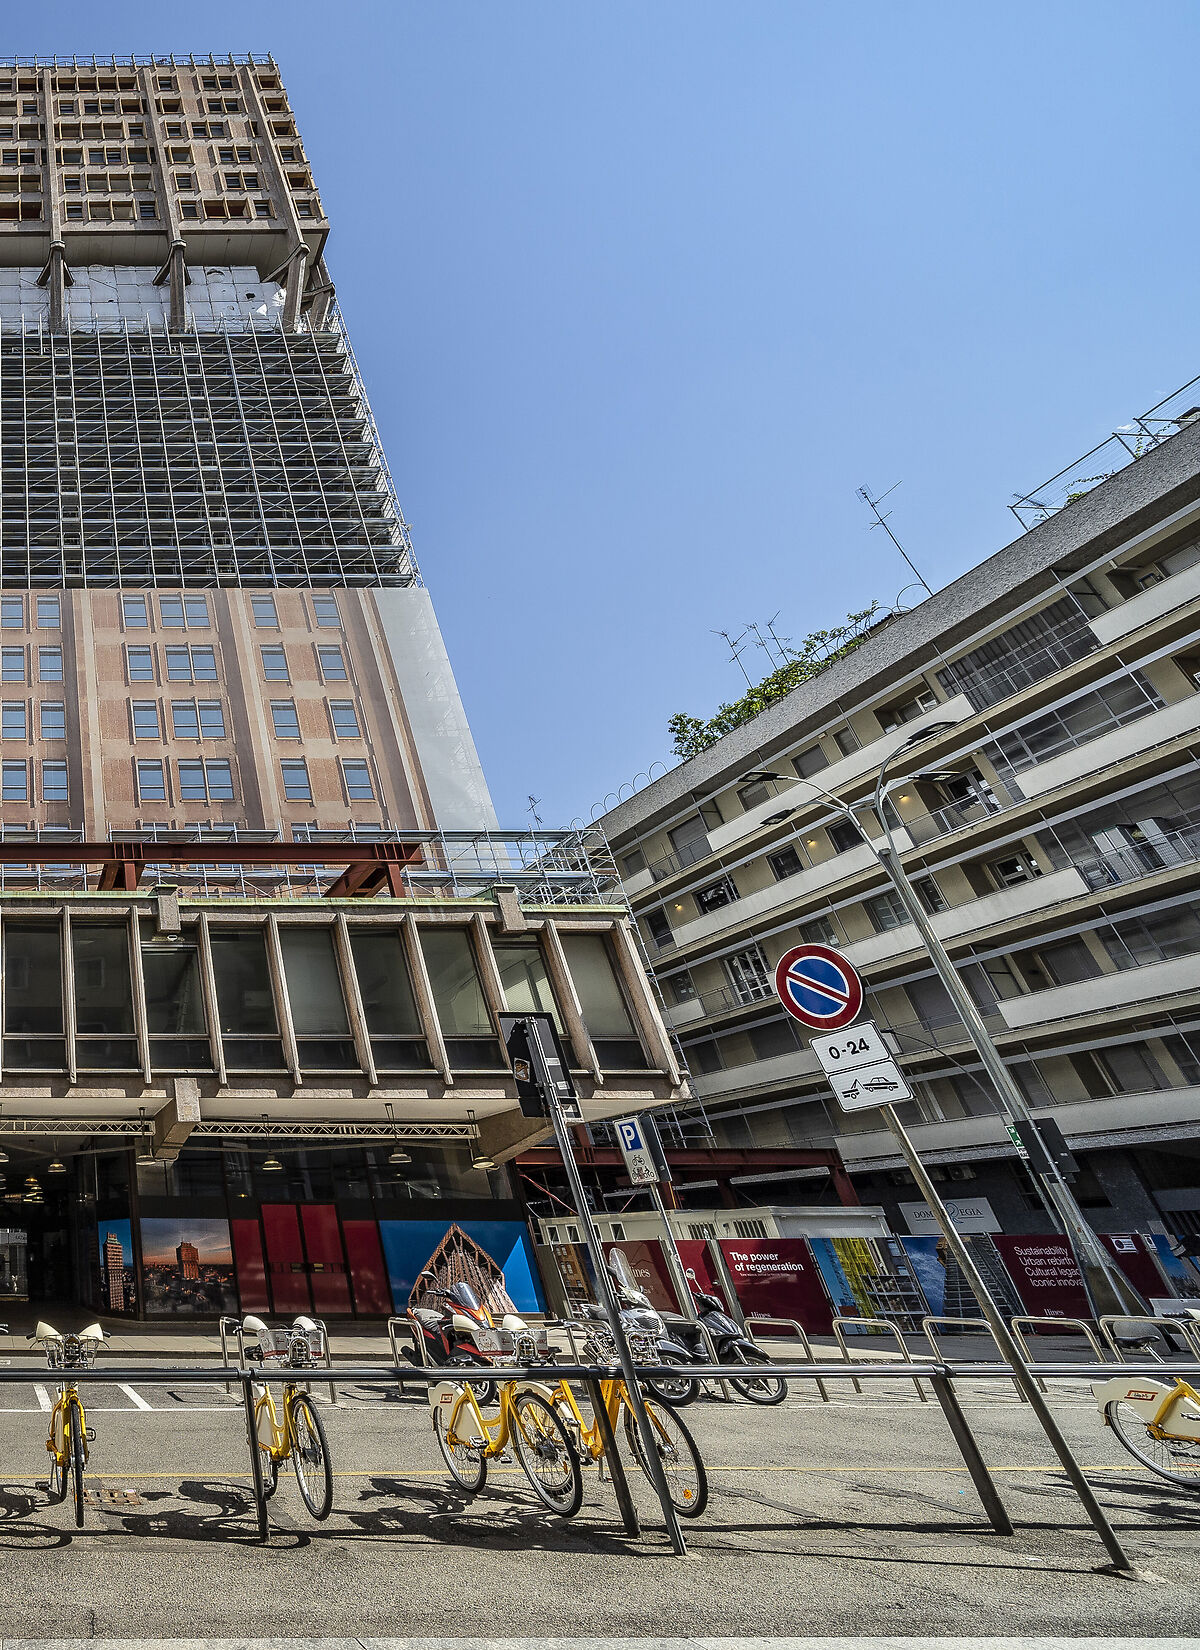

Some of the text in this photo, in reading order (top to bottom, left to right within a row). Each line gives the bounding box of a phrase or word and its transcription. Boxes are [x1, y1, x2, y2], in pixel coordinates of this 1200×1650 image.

[828, 1038, 870, 1059] 0-24
[621, 1124, 636, 1149] P
[729, 1251, 779, 1263] The power
[1013, 1246, 1069, 1257] Sustainability
[734, 1261, 805, 1273] of regeneration
[1018, 1256, 1075, 1266] Urban rebirth
[631, 1266, 651, 1278] ines
[1024, 1267, 1080, 1278] Cultural legac
[1029, 1278, 1083, 1287] Iconic innova
